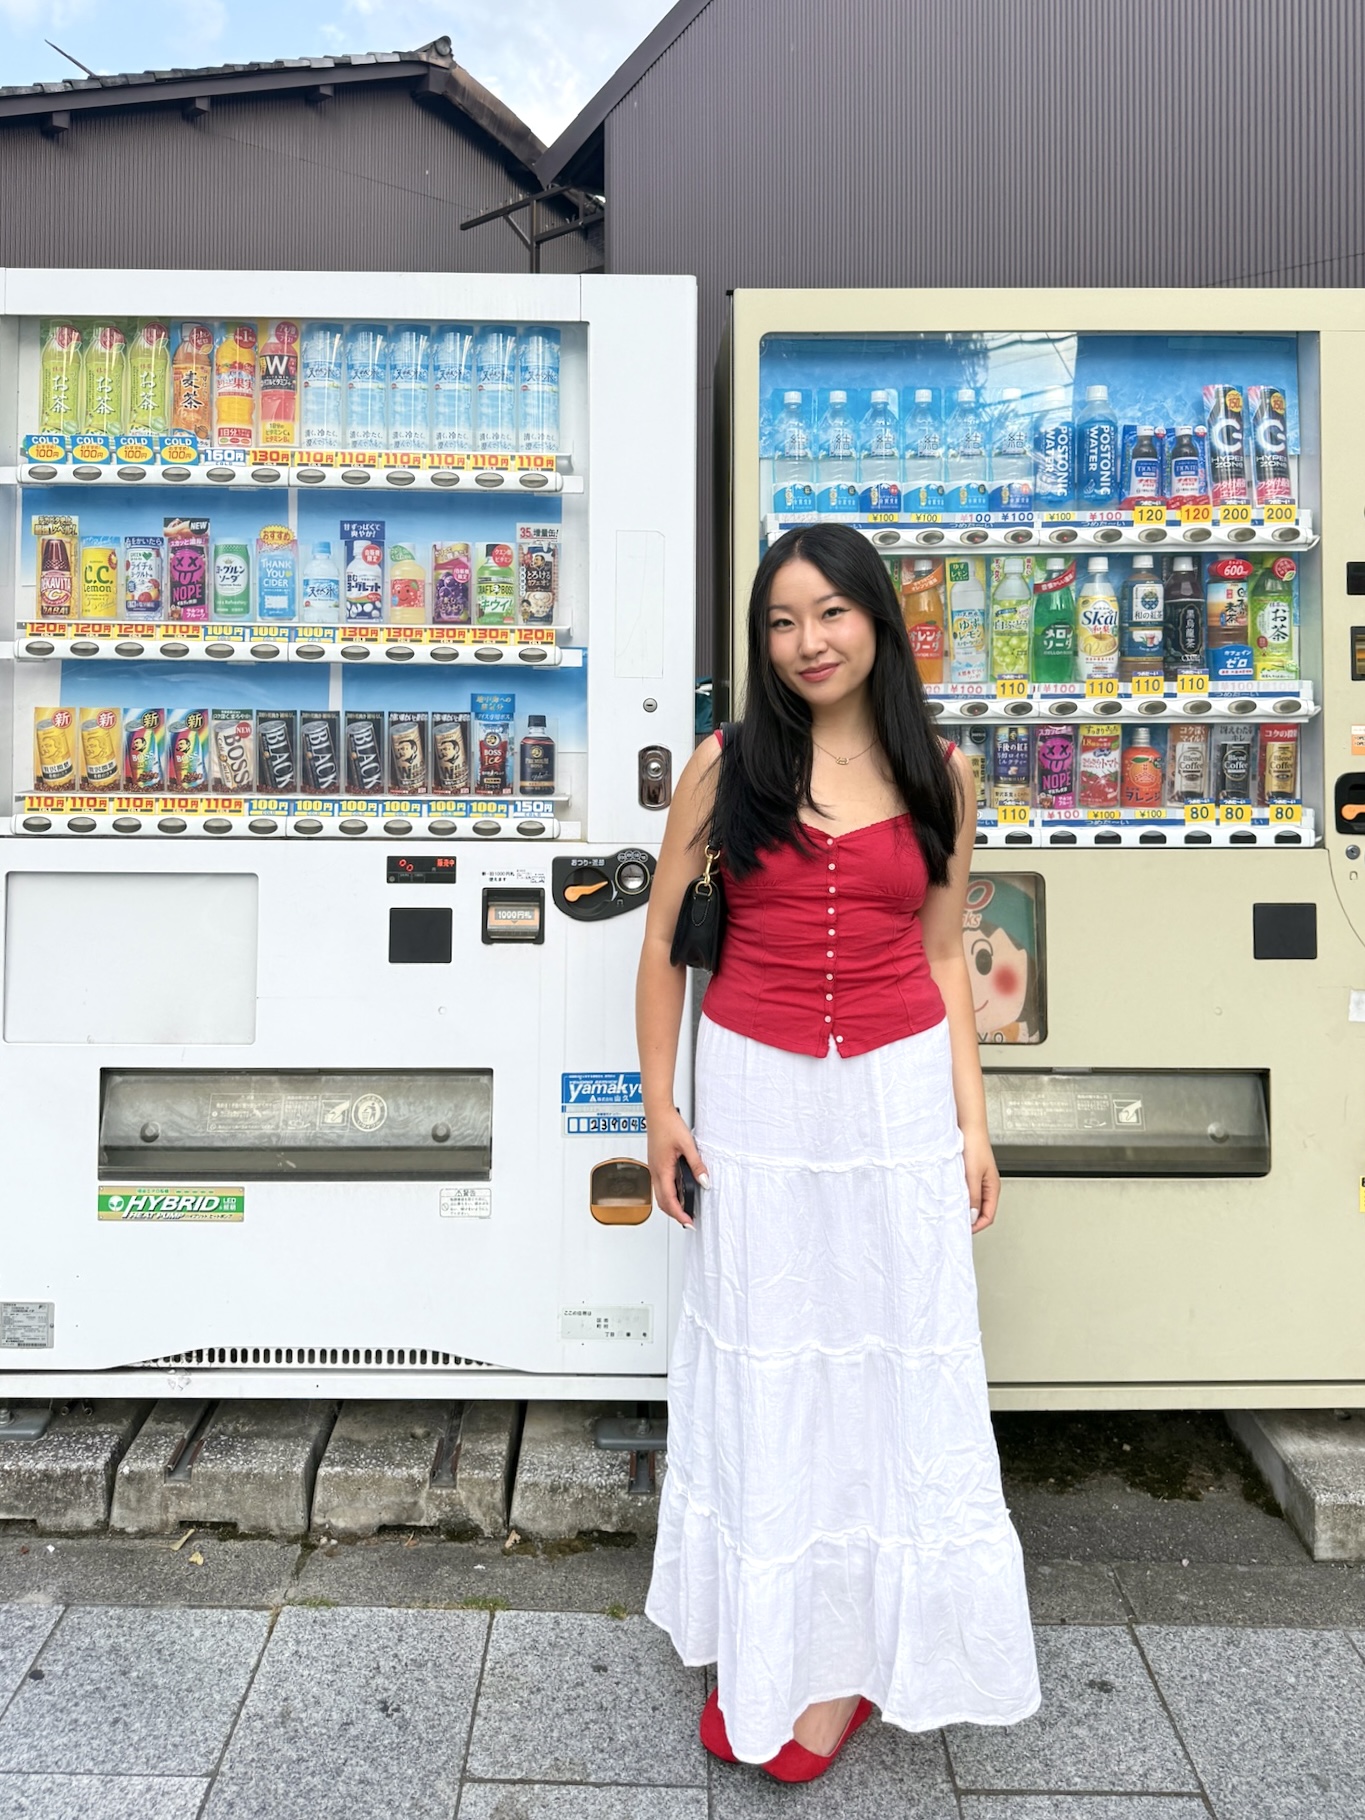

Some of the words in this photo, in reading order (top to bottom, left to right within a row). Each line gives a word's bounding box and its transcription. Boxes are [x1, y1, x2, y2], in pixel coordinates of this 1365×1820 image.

[265, 355, 288, 376] W
[51, 374, 72, 414] お茶
[138, 371, 159, 410] お茶
[182, 370, 203, 409] 麦茶
[94, 376, 116, 415] お茶
[165, 438, 192, 446] COLD
[35, 449, 59, 458] 100円
[1045, 427, 1057, 473] WATER
[1089, 425, 1099, 471] WATER
[79, 450, 103, 459] 100円
[124, 450, 146, 459] 100円
[168, 450, 191, 460] 100円
[206, 449, 244, 461] 160円
[252, 450, 289, 462] 130円
[298, 451, 334, 463] 110円
[340, 452, 376, 464] 110円
[385, 453, 421, 465] 110円
[429, 453, 465, 466] 110円
[472, 454, 509, 466] 110円
[1100, 425, 1112, 495] POSTONIC
[518, 455, 554, 467] 110円
[1057, 425, 1069, 496] POSTONIC
[873, 514, 894, 522] ¥100
[916, 514, 937, 522] ¥100
[960, 514, 991, 522] ¥100
[1001, 512, 1034, 521] ¥100
[1049, 513, 1071, 521] ¥100
[1089, 512, 1122, 521] ¥100
[1138, 509, 1163, 521] 120
[1185, 508, 1210, 520] 120
[1223, 508, 1249, 520] 200
[1267, 508, 1293, 520] 200
[190, 521, 208, 530] NEW
[344, 523, 381, 533] 甘ずっぱくて
[263, 530, 291, 541] おすすめ
[351, 531, 376, 540] 爽やか!
[261, 558, 291, 569] THANK
[219, 574, 240, 583] ソーダ
[266, 569, 284, 580] YOU
[263, 580, 289, 590] CIDER
[347, 583, 381, 592] ヨーグレット
[173, 584, 203, 602] NOPE
[482, 600, 513, 612] キウイ!
[1134, 611, 1163, 620] 和の紅茶
[30, 623, 66, 633] 120円
[75, 623, 112, 633] 120円
[118, 623, 155, 633] 120円
[164, 624, 200, 634] 110円
[206, 625, 244, 636] 100円
[959, 619, 980, 631] ゆず
[994, 620, 1029, 631] 白ぶどう
[1185, 609, 1196, 649] 黒烏龍茶
[1269, 608, 1289, 642] お茶
[251, 626, 289, 636] 100円
[297, 627, 333, 638] 100円
[341, 627, 378, 638] 130円
[386, 628, 423, 638] 130円
[430, 628, 466, 639] 130円
[472, 628, 508, 639] 130円
[517, 629, 554, 641] 120円
[958, 630, 982, 641] レモン
[1044, 639, 1072, 650] ソーダ
[1226, 657, 1248, 668] ゼロ
[951, 685, 983, 694] ¥100
[1001, 682, 1025, 695] 110
[1044, 684, 1076, 693] ¥100
[1089, 682, 1114, 694] 110
[1136, 678, 1160, 692] 110
[1180, 677, 1205, 691] 110
[54, 712, 71, 728] 新
[98, 712, 115, 728] 新
[143, 713, 158, 728] 新
[188, 713, 203, 728] 新
[236, 726, 252, 734] NEW
[223, 733, 250, 785] BOSS
[266, 727, 296, 788] BLACK
[309, 728, 338, 789] BLACK
[353, 728, 382, 789] BLACK
[1042, 771, 1071, 790] NOPE
[28, 796, 64, 808] 110円
[70, 797, 107, 808] 110円
[117, 797, 154, 809] 110円
[161, 798, 199, 809] 110円
[205, 799, 242, 809] 110円
[252, 799, 289, 810] 100円
[297, 800, 333, 811] 100円
[341, 800, 377, 811] 100円
[385, 801, 421, 811] 100円
[430, 801, 466, 812] 100円
[470, 802, 507, 812] 100円
[516, 802, 553, 812] 150円
[1002, 808, 1026, 821] 110
[1047, 811, 1080, 820] ¥100
[1092, 811, 1115, 819] ¥100
[1139, 810, 1161, 818] ¥100
[1190, 806, 1209, 819] 80
[1225, 807, 1244, 819] 80
[1275, 807, 1294, 819] 80
[497, 910, 532, 920] 1000円札
[122, 1195, 221, 1219] HYBRID
